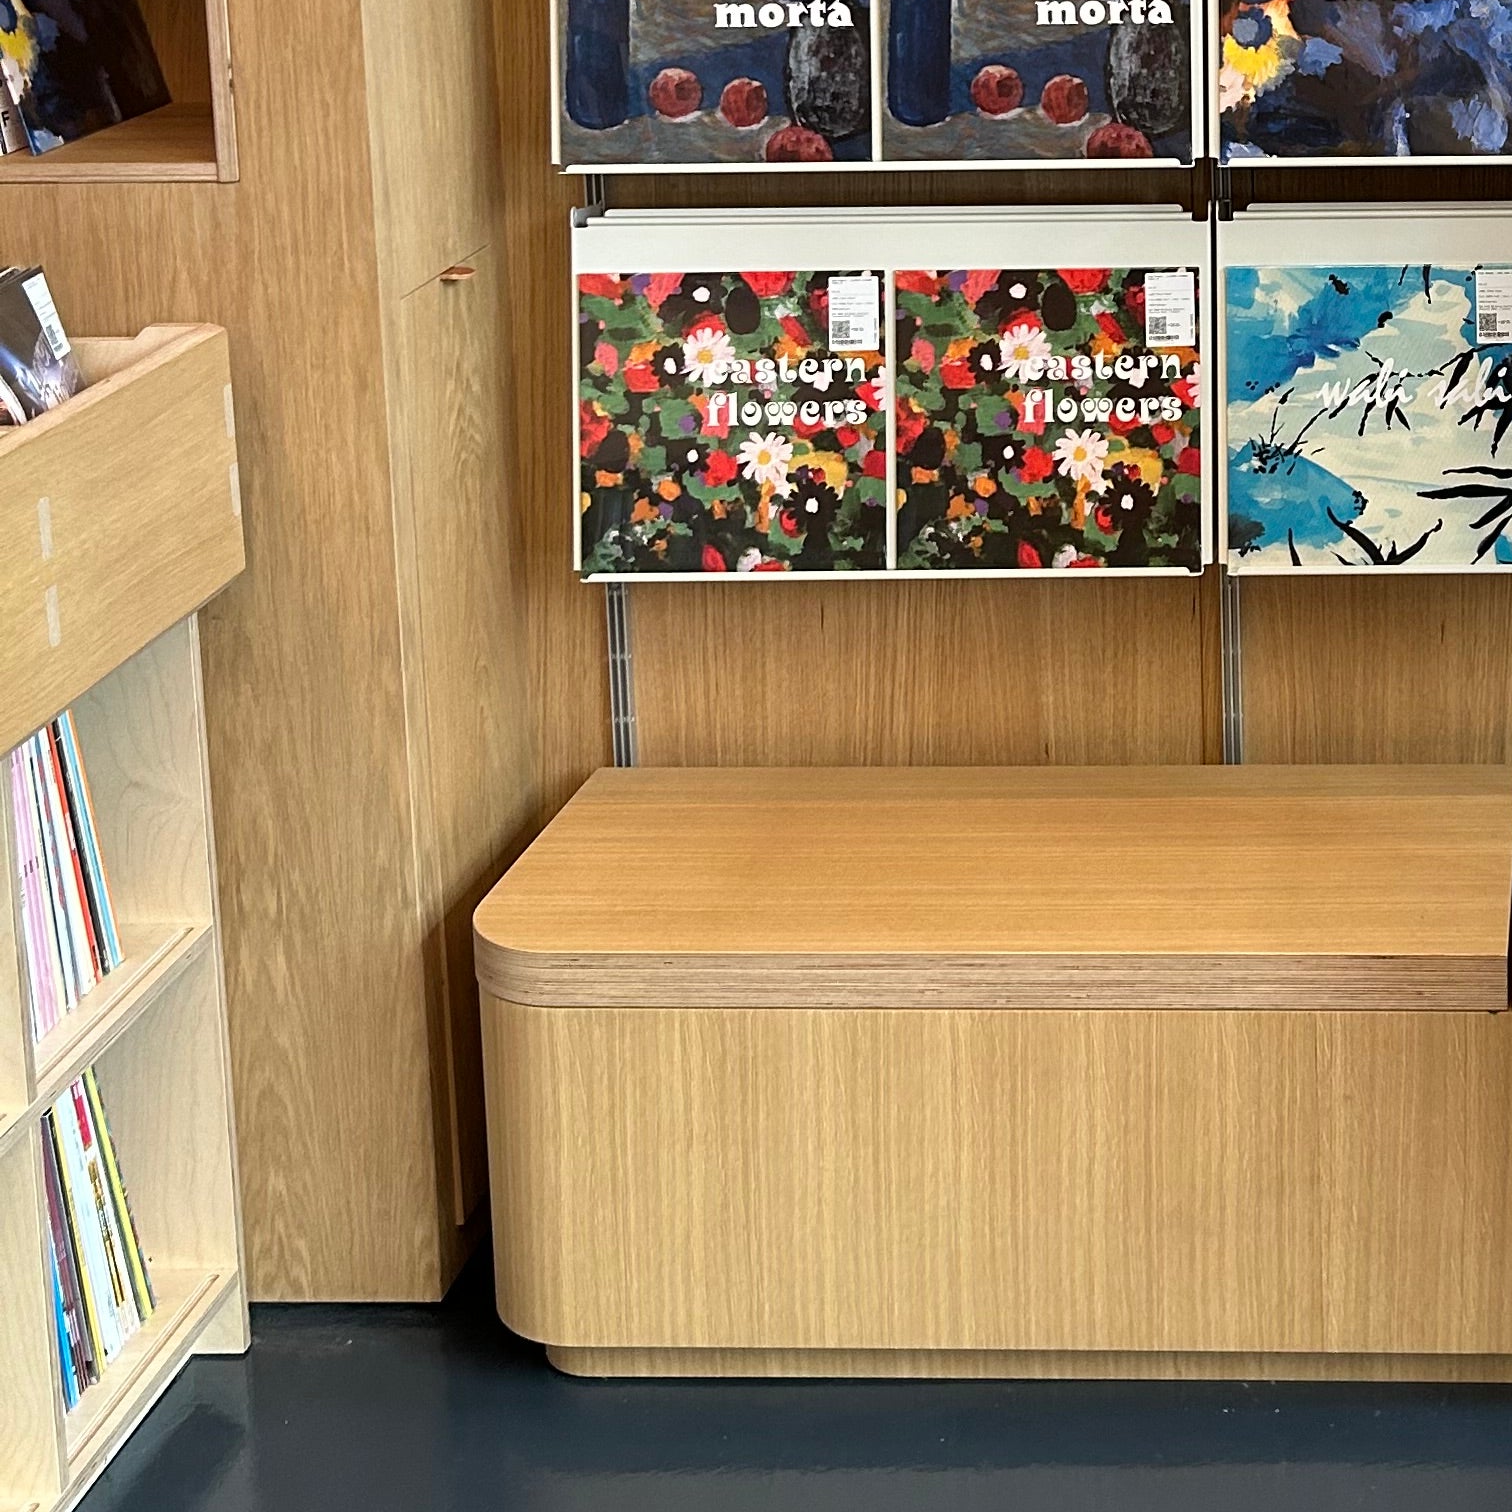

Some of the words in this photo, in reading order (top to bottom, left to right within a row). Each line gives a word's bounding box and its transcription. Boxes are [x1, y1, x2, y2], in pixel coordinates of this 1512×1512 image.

[709, 352, 868, 385] eastern
[1028, 349, 1183, 381] eastern
[1315, 357, 1414, 409] wabi
[1427, 356, 1512, 407] sabi
[706, 391, 868, 427] flowers
[1022, 388, 1183, 424] flowers
